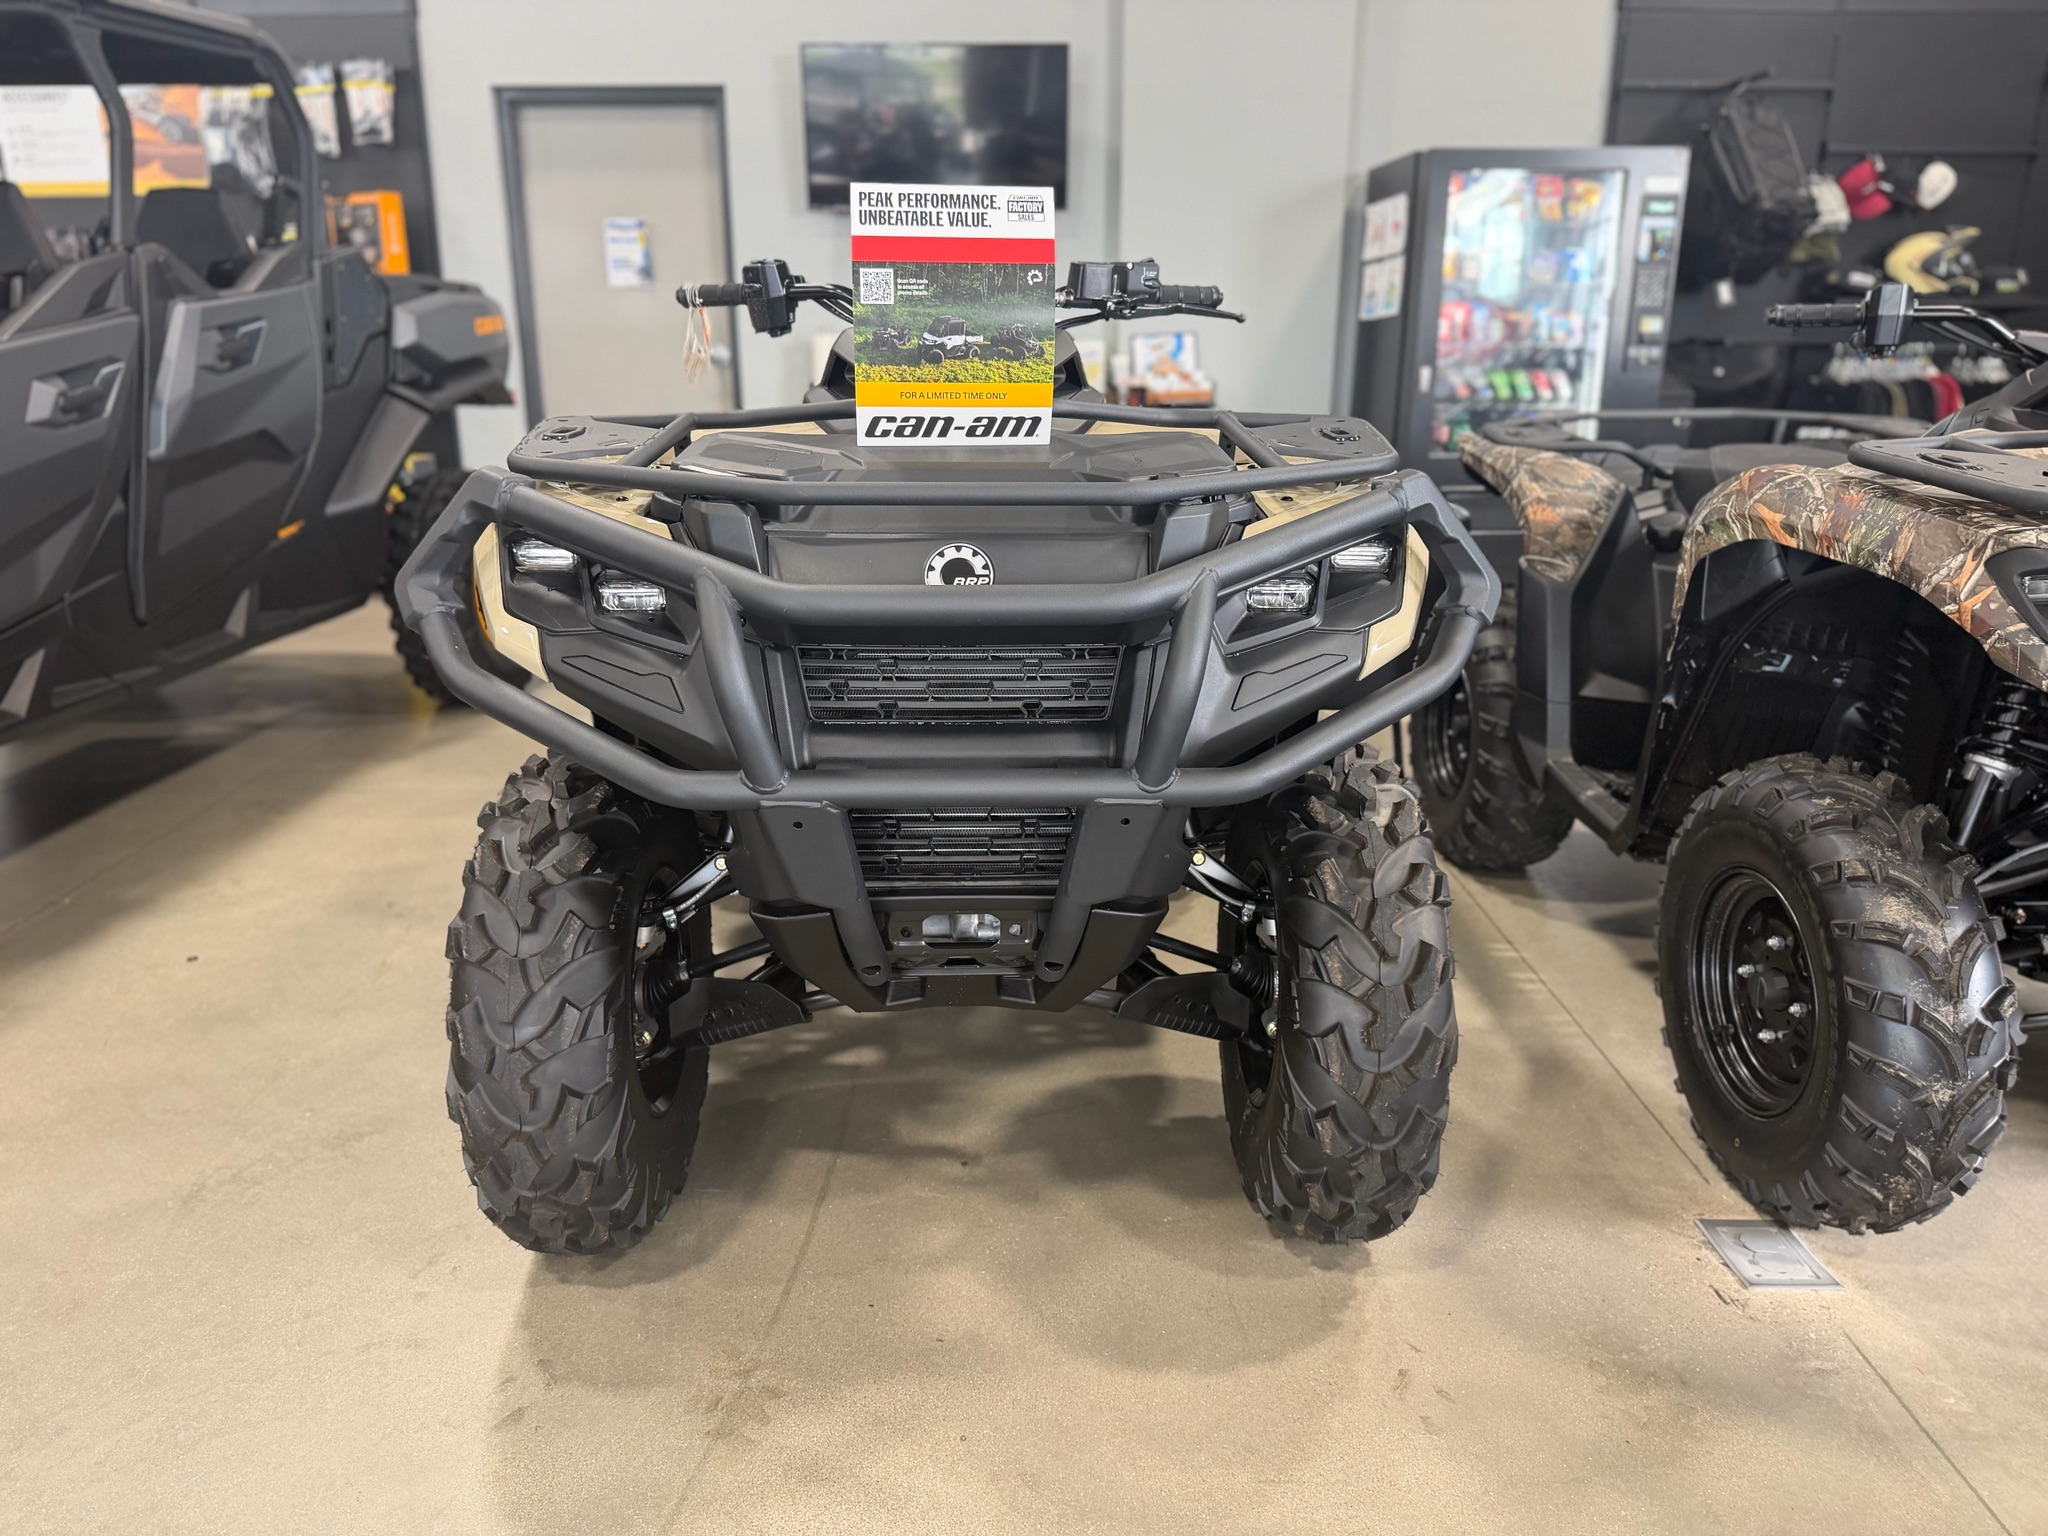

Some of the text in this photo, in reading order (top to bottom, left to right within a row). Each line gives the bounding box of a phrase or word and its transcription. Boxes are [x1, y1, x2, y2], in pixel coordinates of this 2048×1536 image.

[859, 191, 1001, 210] PEAK PERFORMANCE.
[1008, 201, 1043, 213] FACTORY
[859, 209, 992, 228] UNBEATABLE VALUE.
[1018, 213, 1035, 221] SALES
[900, 391, 1008, 400] FOR A LIMITED TIME ONLY
[864, 416, 1043, 438] can-am
